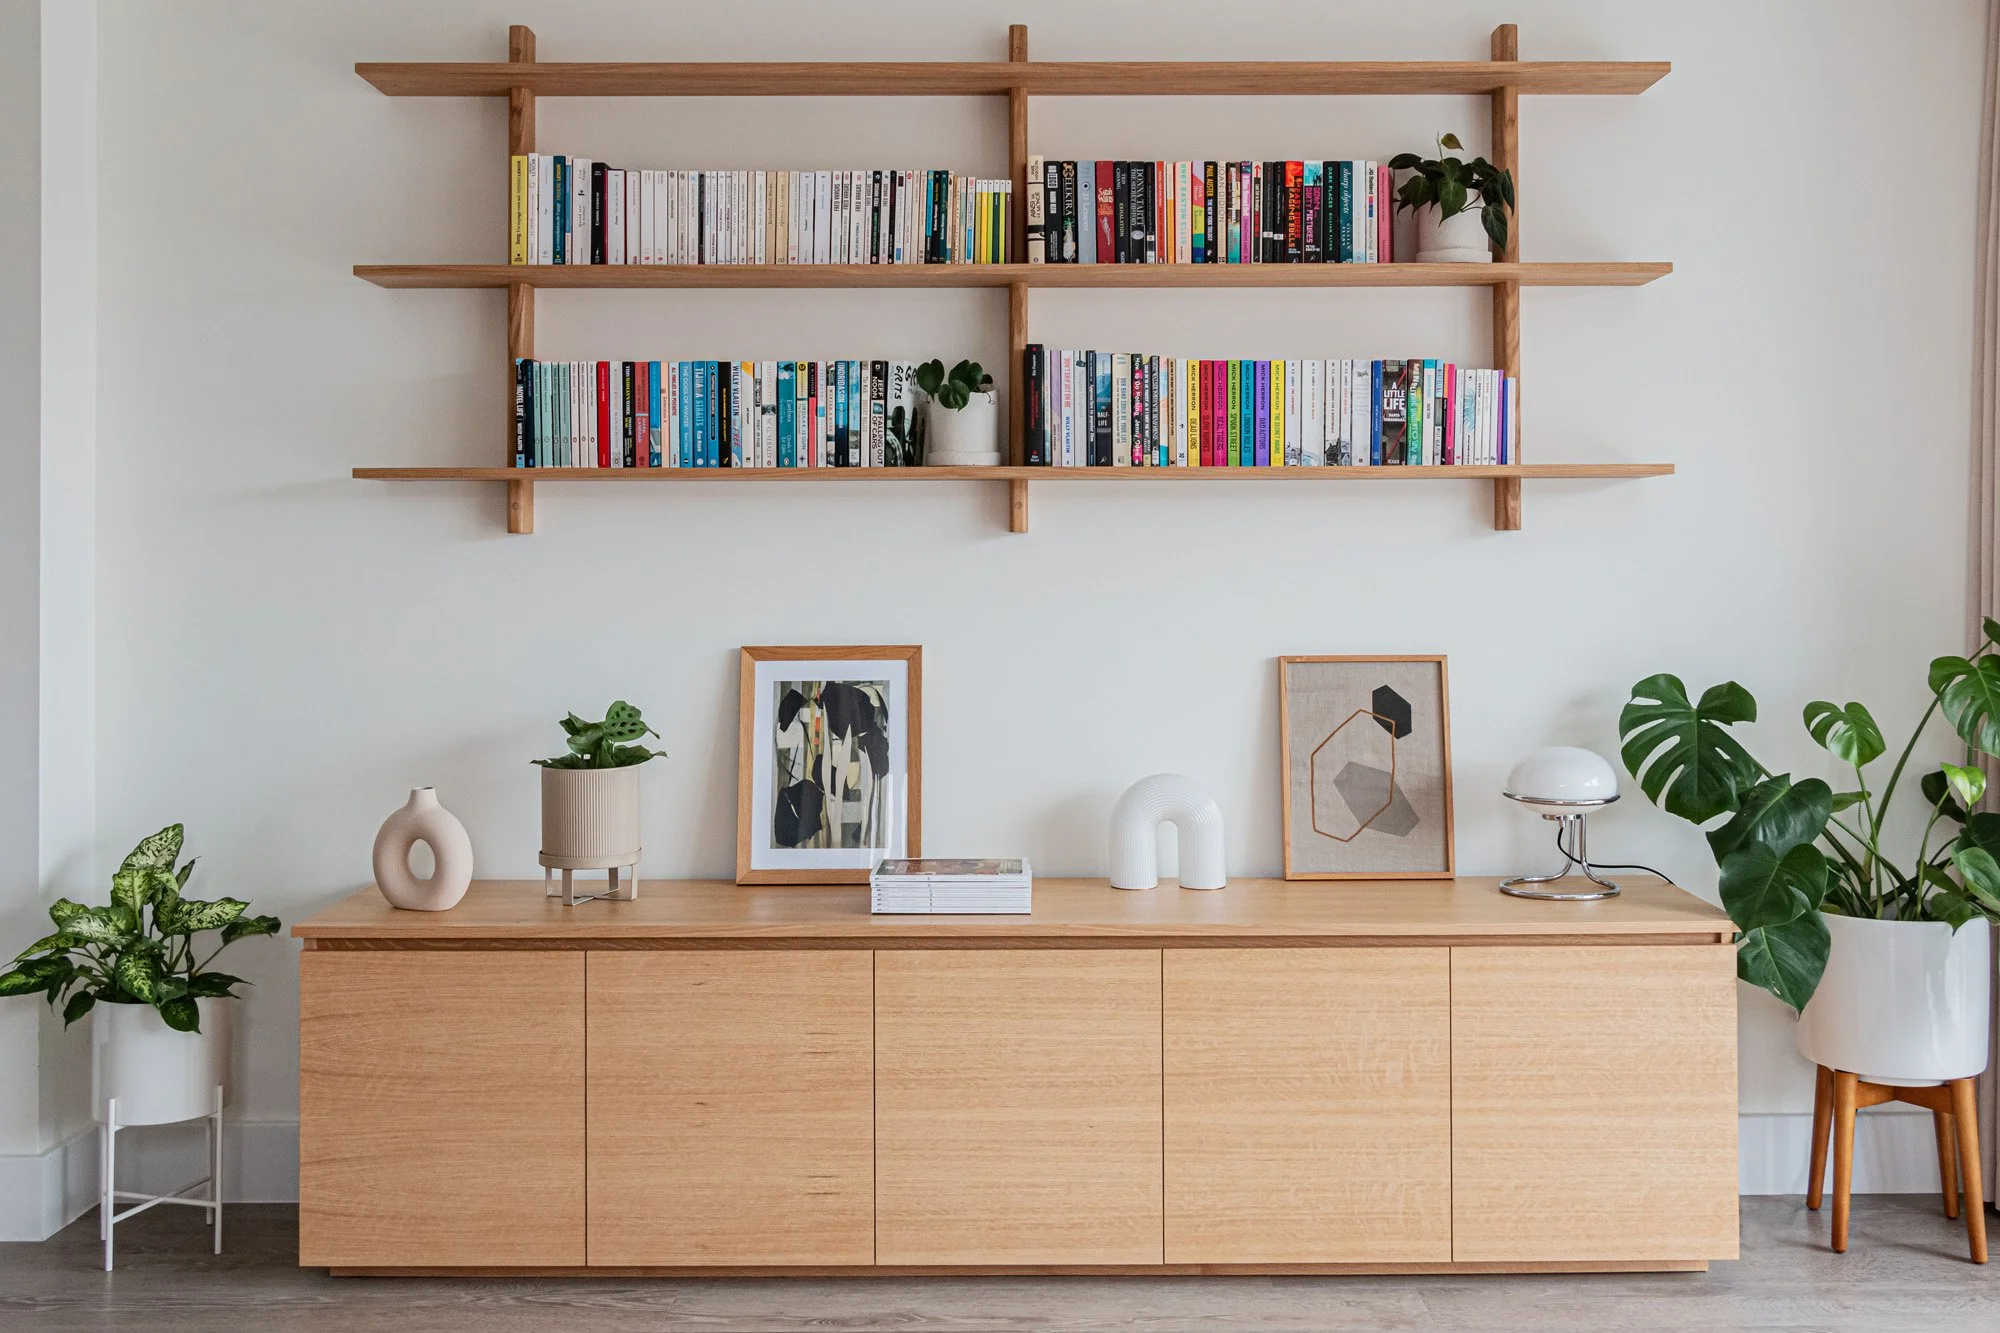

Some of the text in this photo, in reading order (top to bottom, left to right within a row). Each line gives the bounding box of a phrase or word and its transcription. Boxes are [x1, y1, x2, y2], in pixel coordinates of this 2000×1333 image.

[1065, 178, 1073, 216] ELEKTRA
[1305, 187, 1313, 209] DIRTY
[1341, 168, 1351, 214] sharp objects
[894, 365, 904, 400] GRITS
[1391, 381, 1398, 390] A
[516, 386, 524, 405] MOTEL
[695, 368, 704, 427] TIJUANA STRAITS
[1383, 389, 1406, 398] LITTLE
[516, 405, 524, 417] LIFE
[1383, 397, 1405, 410] LIFE
[872, 416, 878, 427] OF
[1202, 414, 1210, 430] SLOW
[1202, 431, 1210, 453] HORSES
